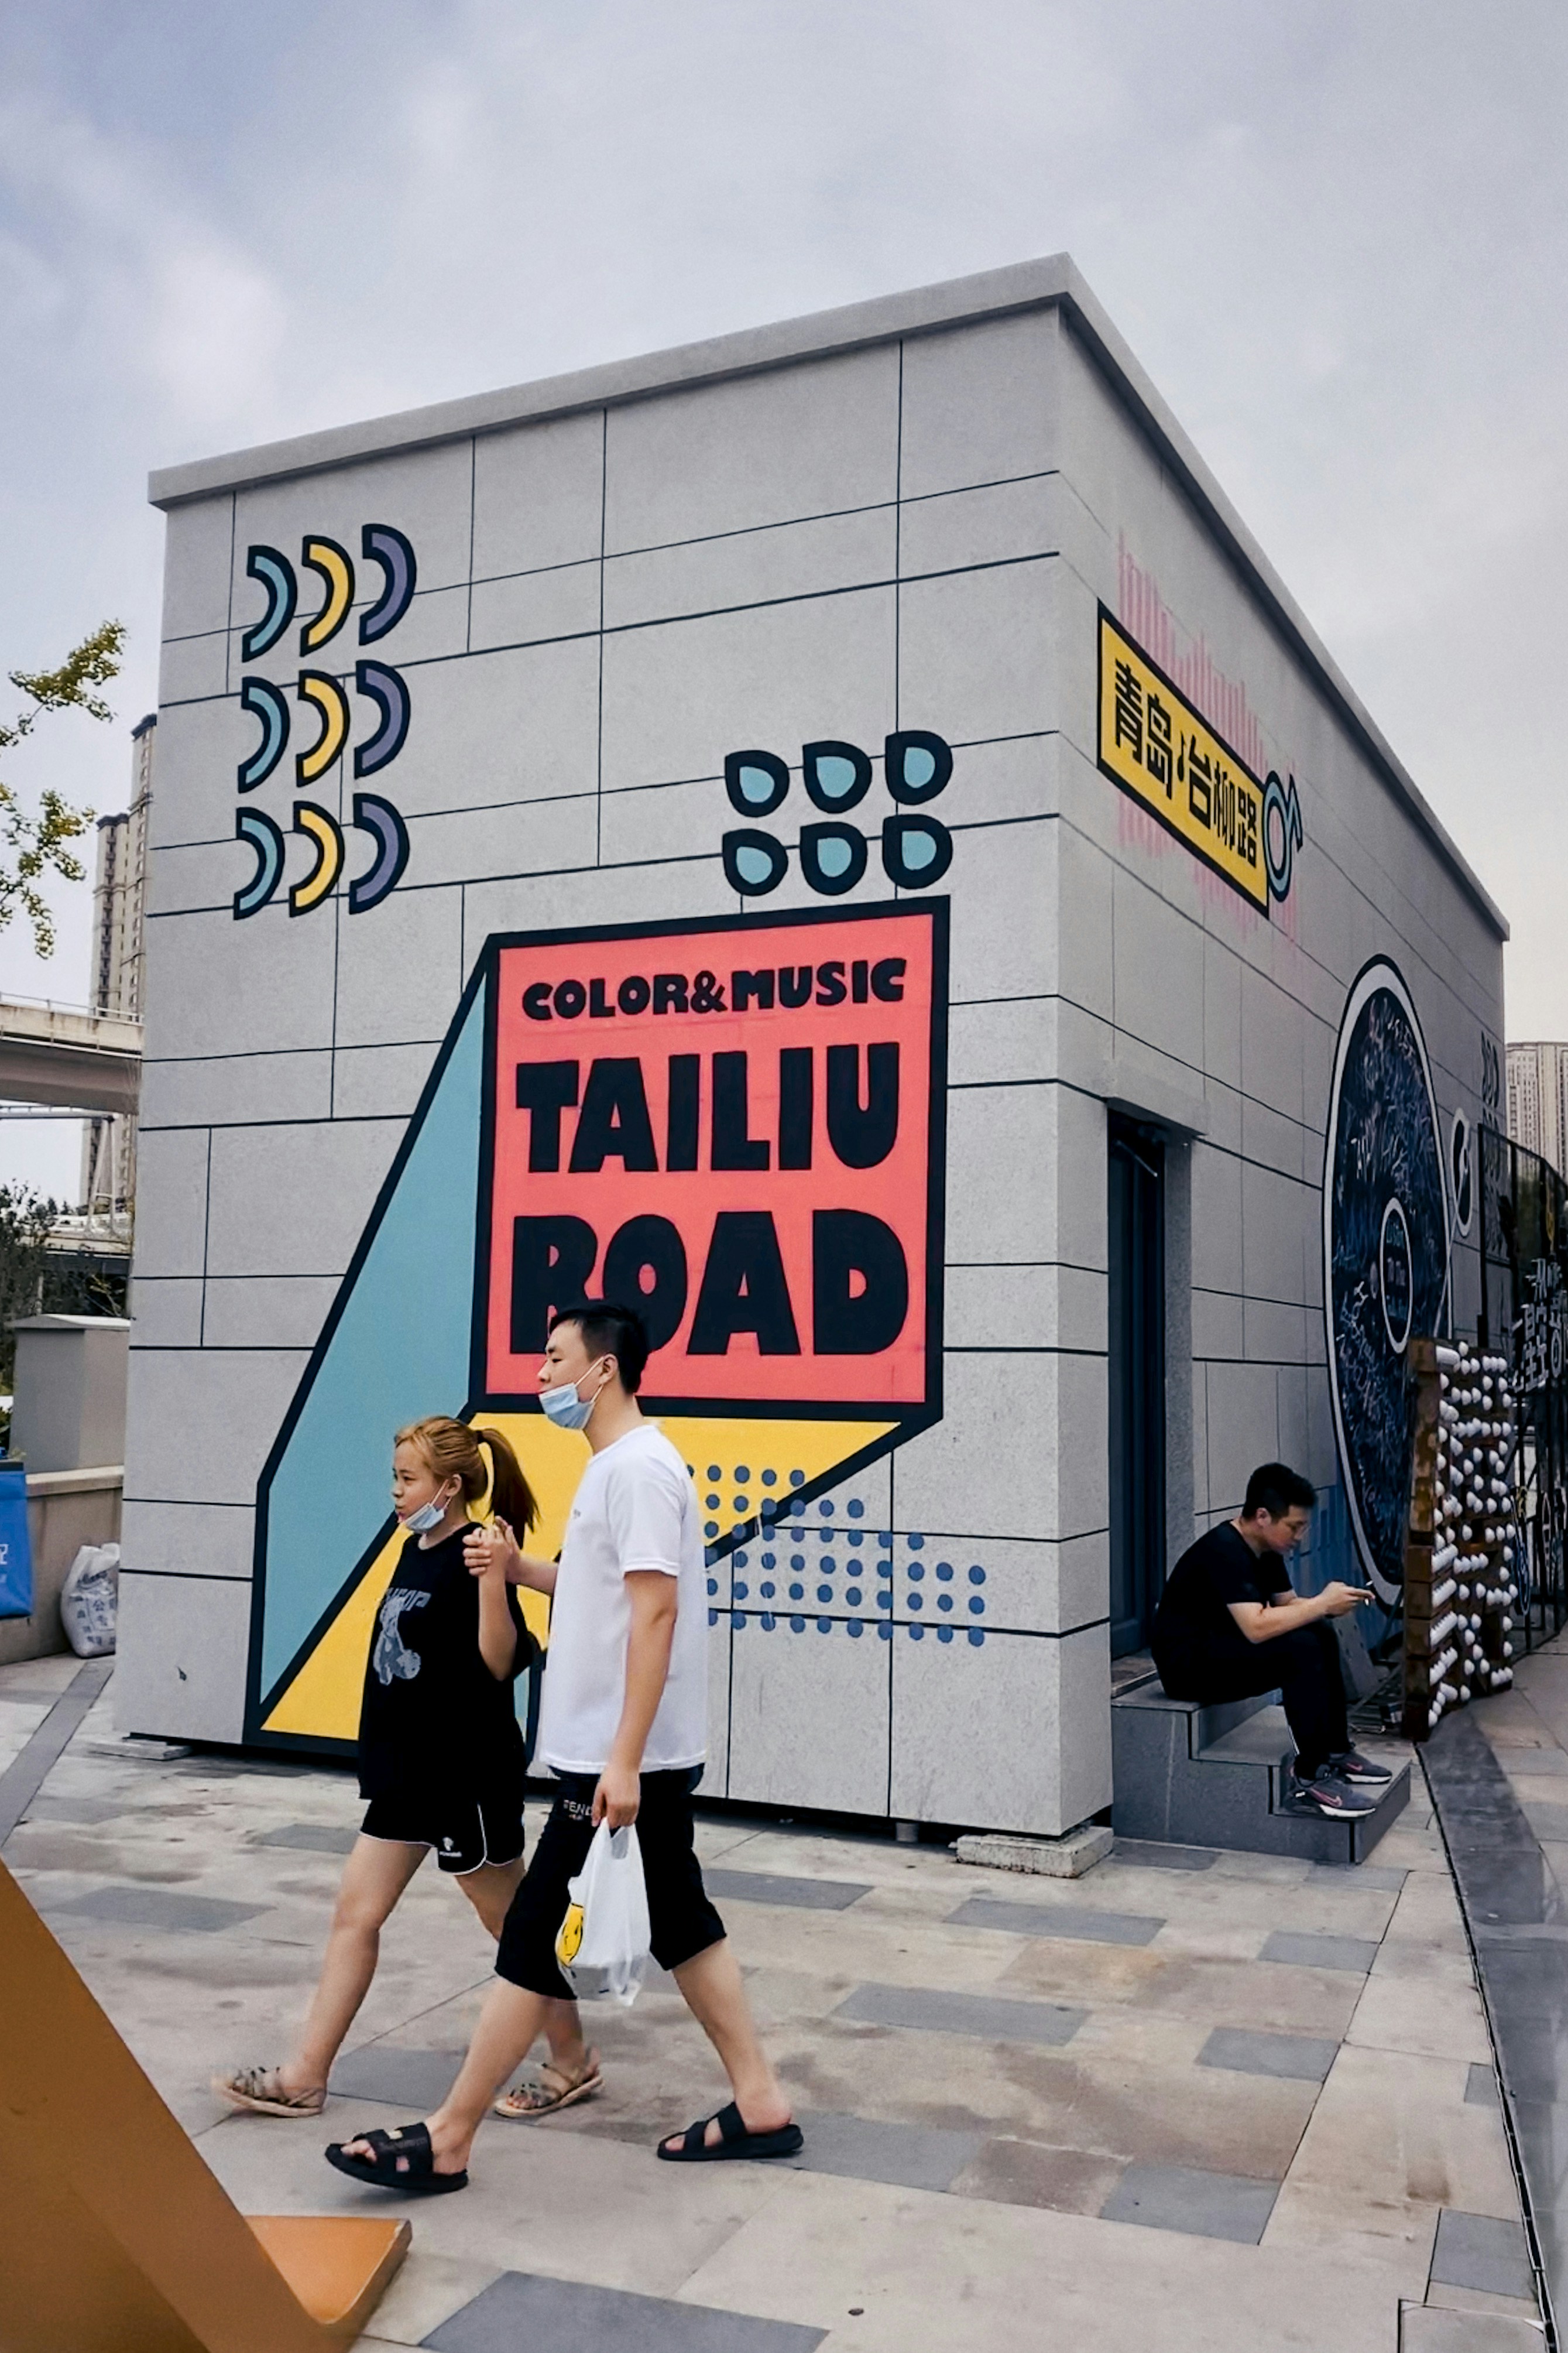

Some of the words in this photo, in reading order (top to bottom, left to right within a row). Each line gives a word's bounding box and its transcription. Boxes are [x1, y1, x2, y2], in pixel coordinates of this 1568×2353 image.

[521, 958, 907, 1020] COLOR&MUSIC
[516, 1042, 900, 1173] TAILIU
[511, 1210, 909, 1355] ROAD
